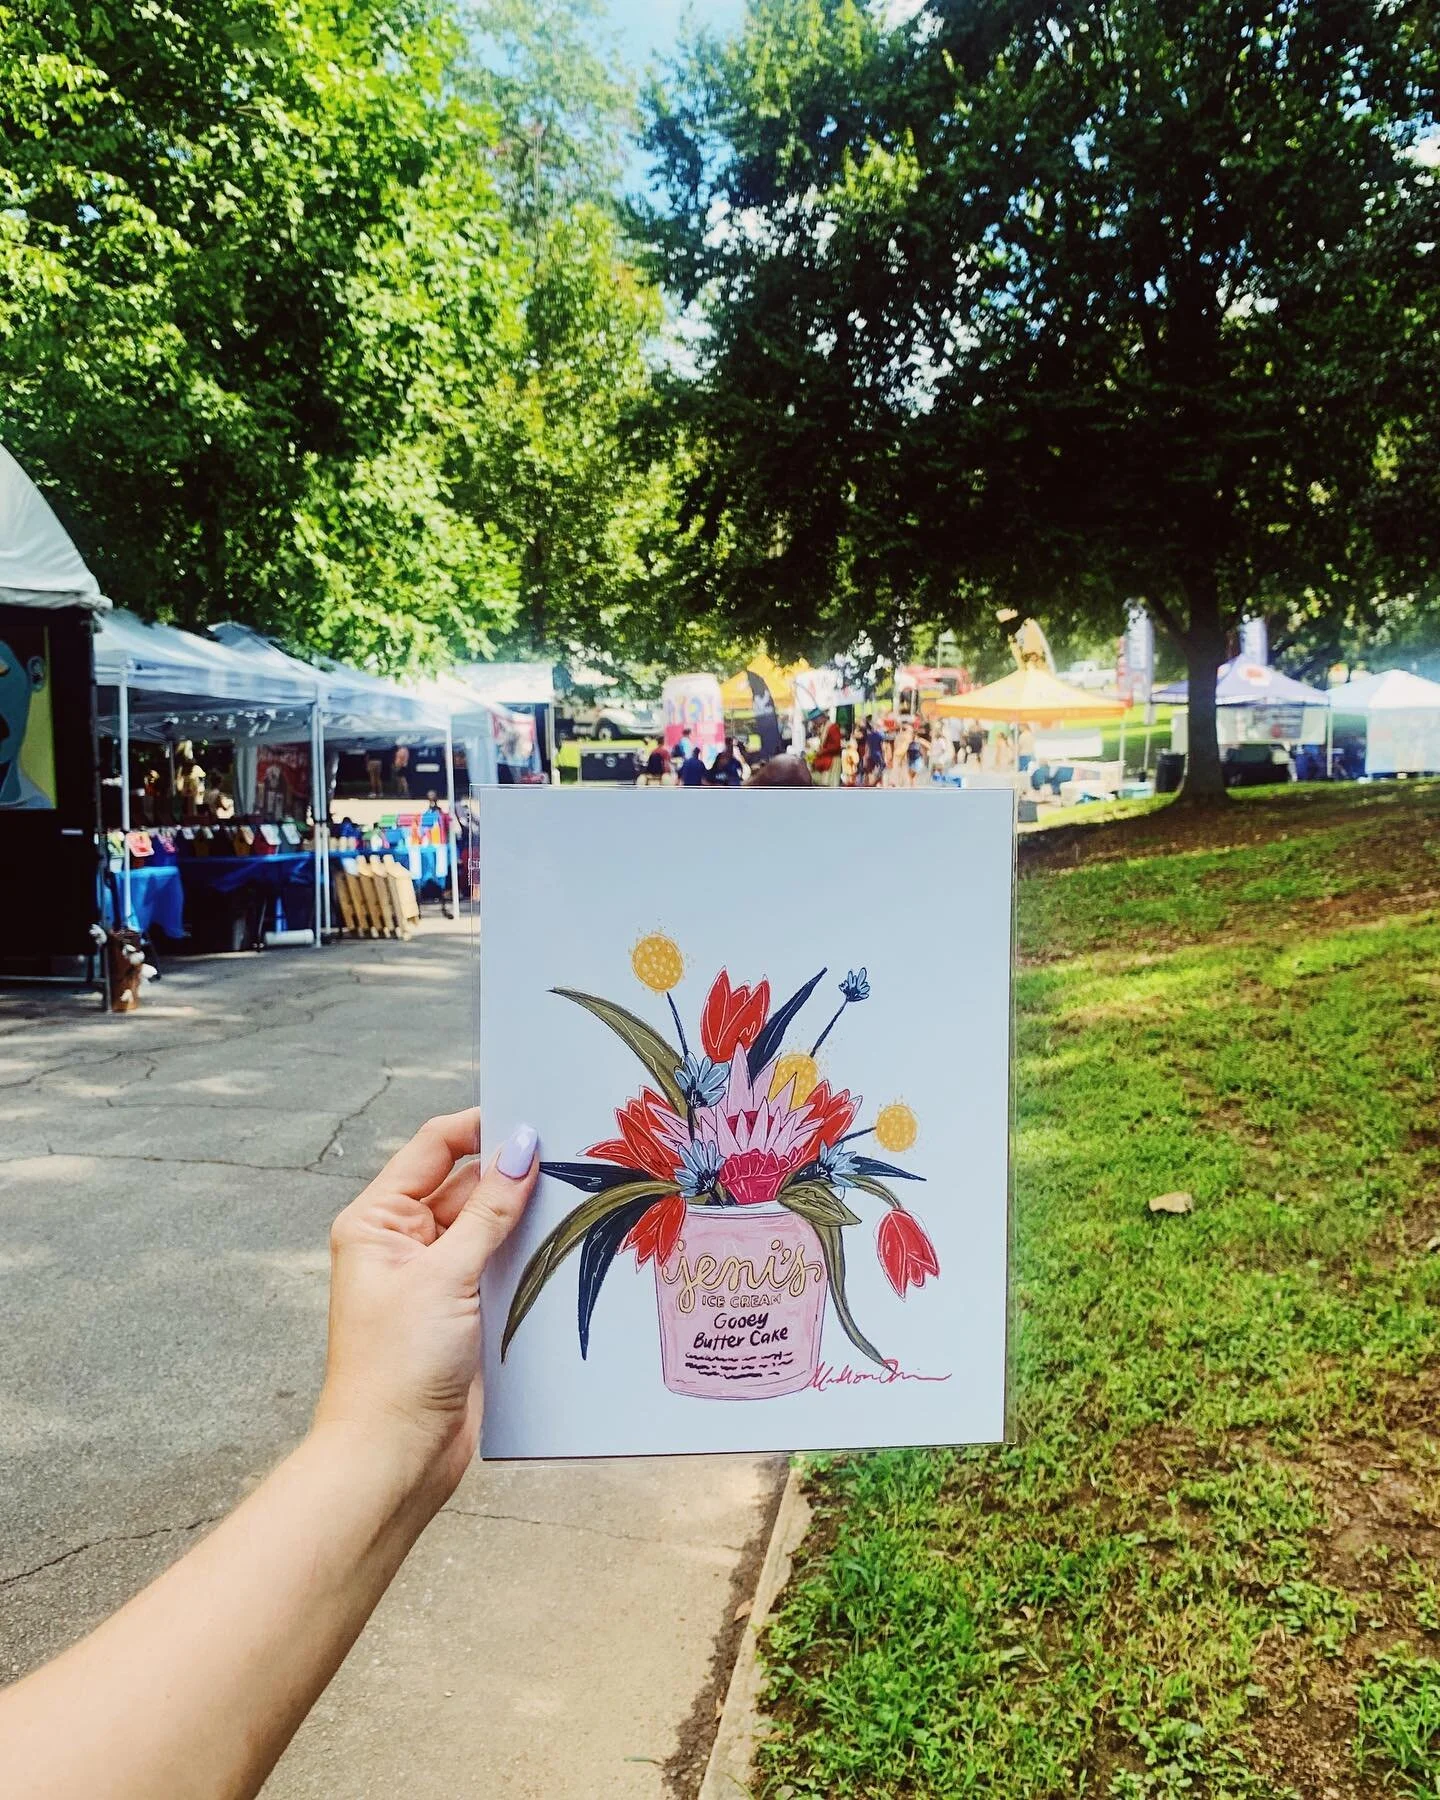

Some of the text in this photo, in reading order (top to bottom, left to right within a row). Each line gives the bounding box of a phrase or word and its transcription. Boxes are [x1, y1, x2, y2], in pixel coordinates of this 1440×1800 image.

[701, 1294, 781, 1308] ICE CREAM
[714, 1312, 769, 1329] Gooey
[693, 1327, 788, 1350] Butter Cake
